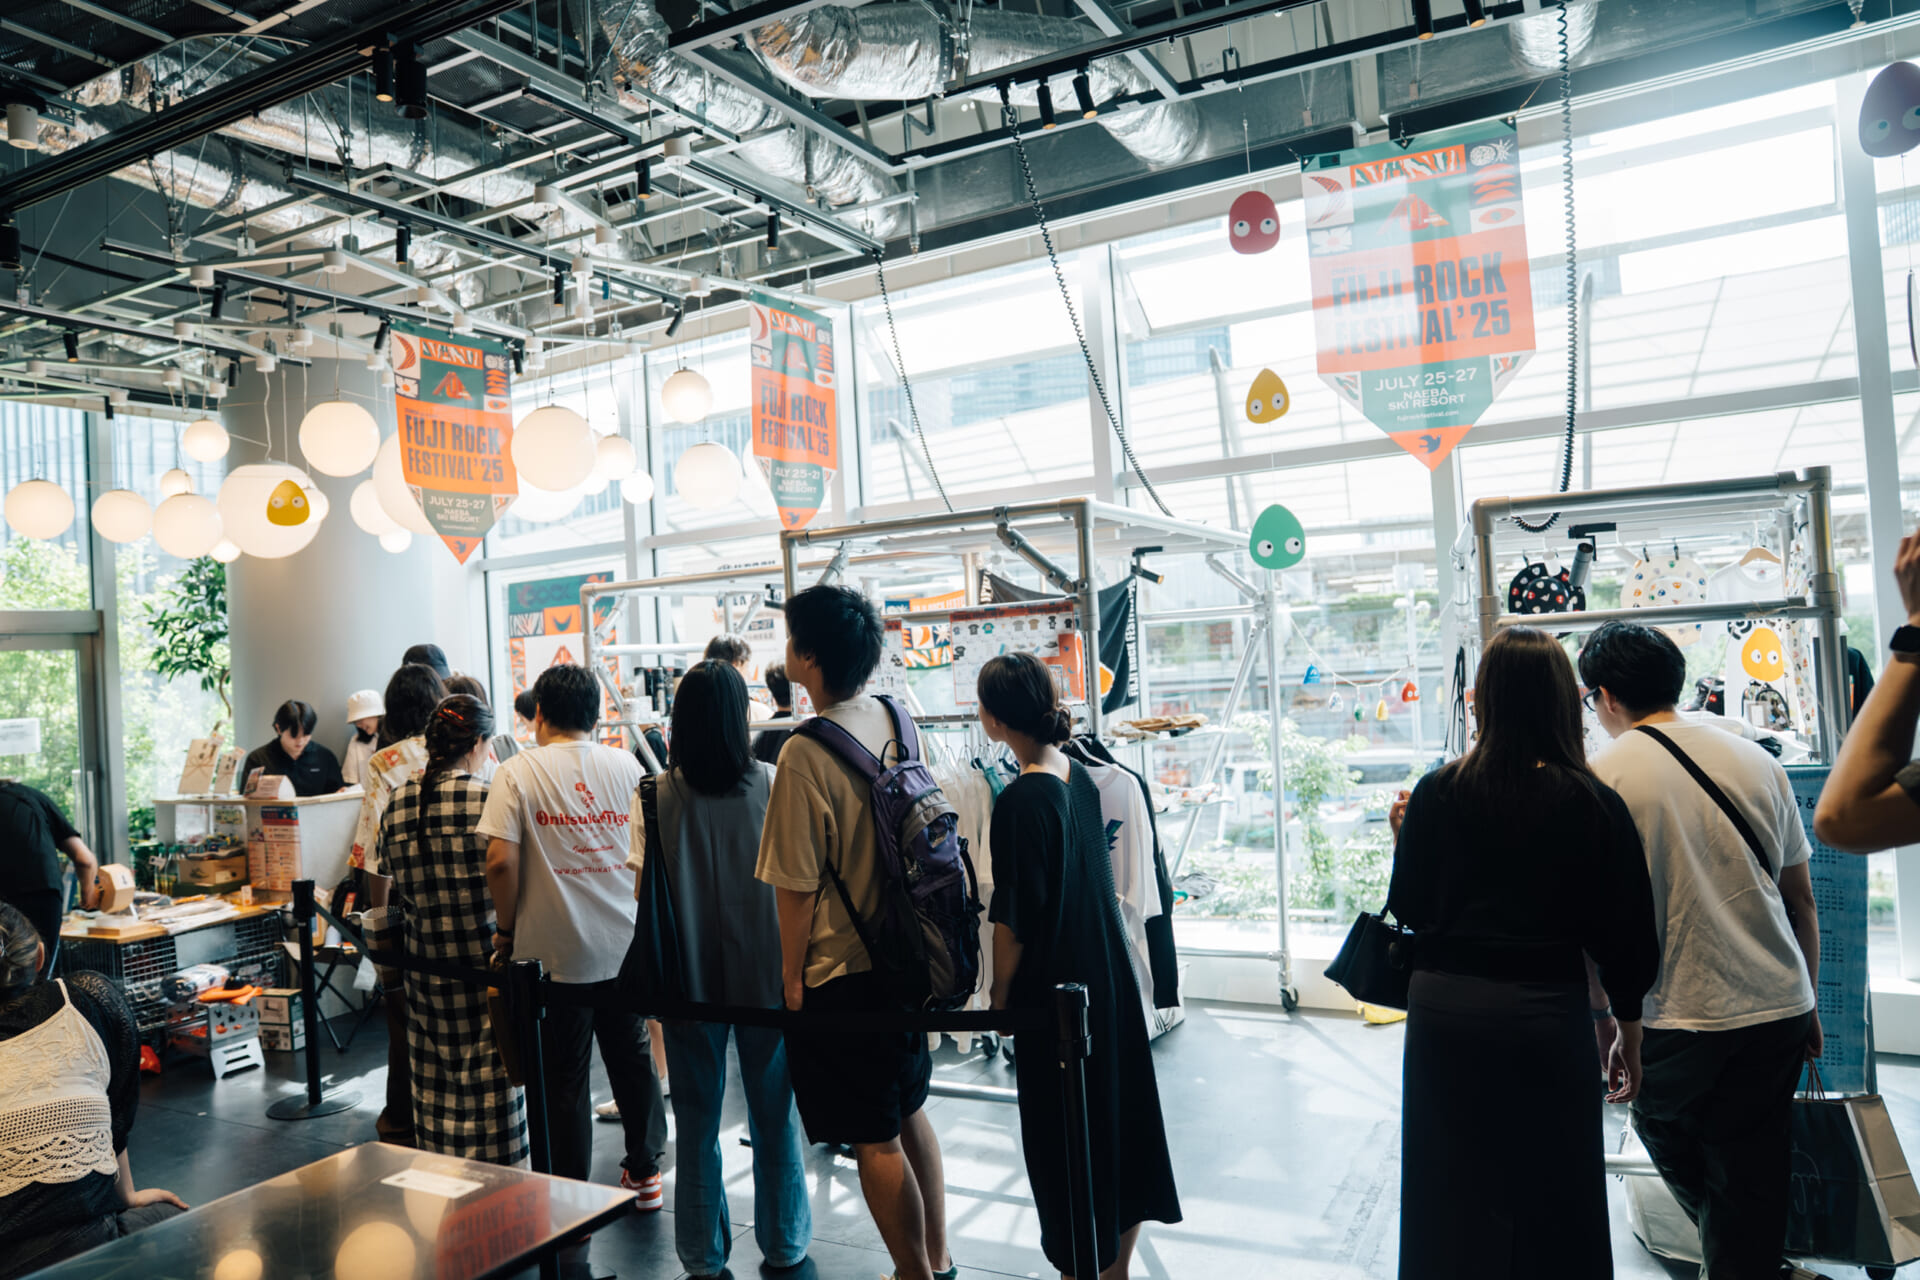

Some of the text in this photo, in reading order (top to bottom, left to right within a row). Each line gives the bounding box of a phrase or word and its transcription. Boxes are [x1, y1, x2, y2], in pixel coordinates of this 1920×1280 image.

[1331, 252, 1507, 316] FUJI ROCK
[1374, 367, 1477, 391] JULY 25-27
[1388, 393, 1466, 411] SKI RESORT
[1403, 388, 1448, 400] NAEBA
[761, 385, 828, 430] FUJI ROCK
[405, 414, 502, 456] FUJI ROCK
[428, 496, 486, 510] JULY 25-27
[602, 810, 630, 827] Tige
